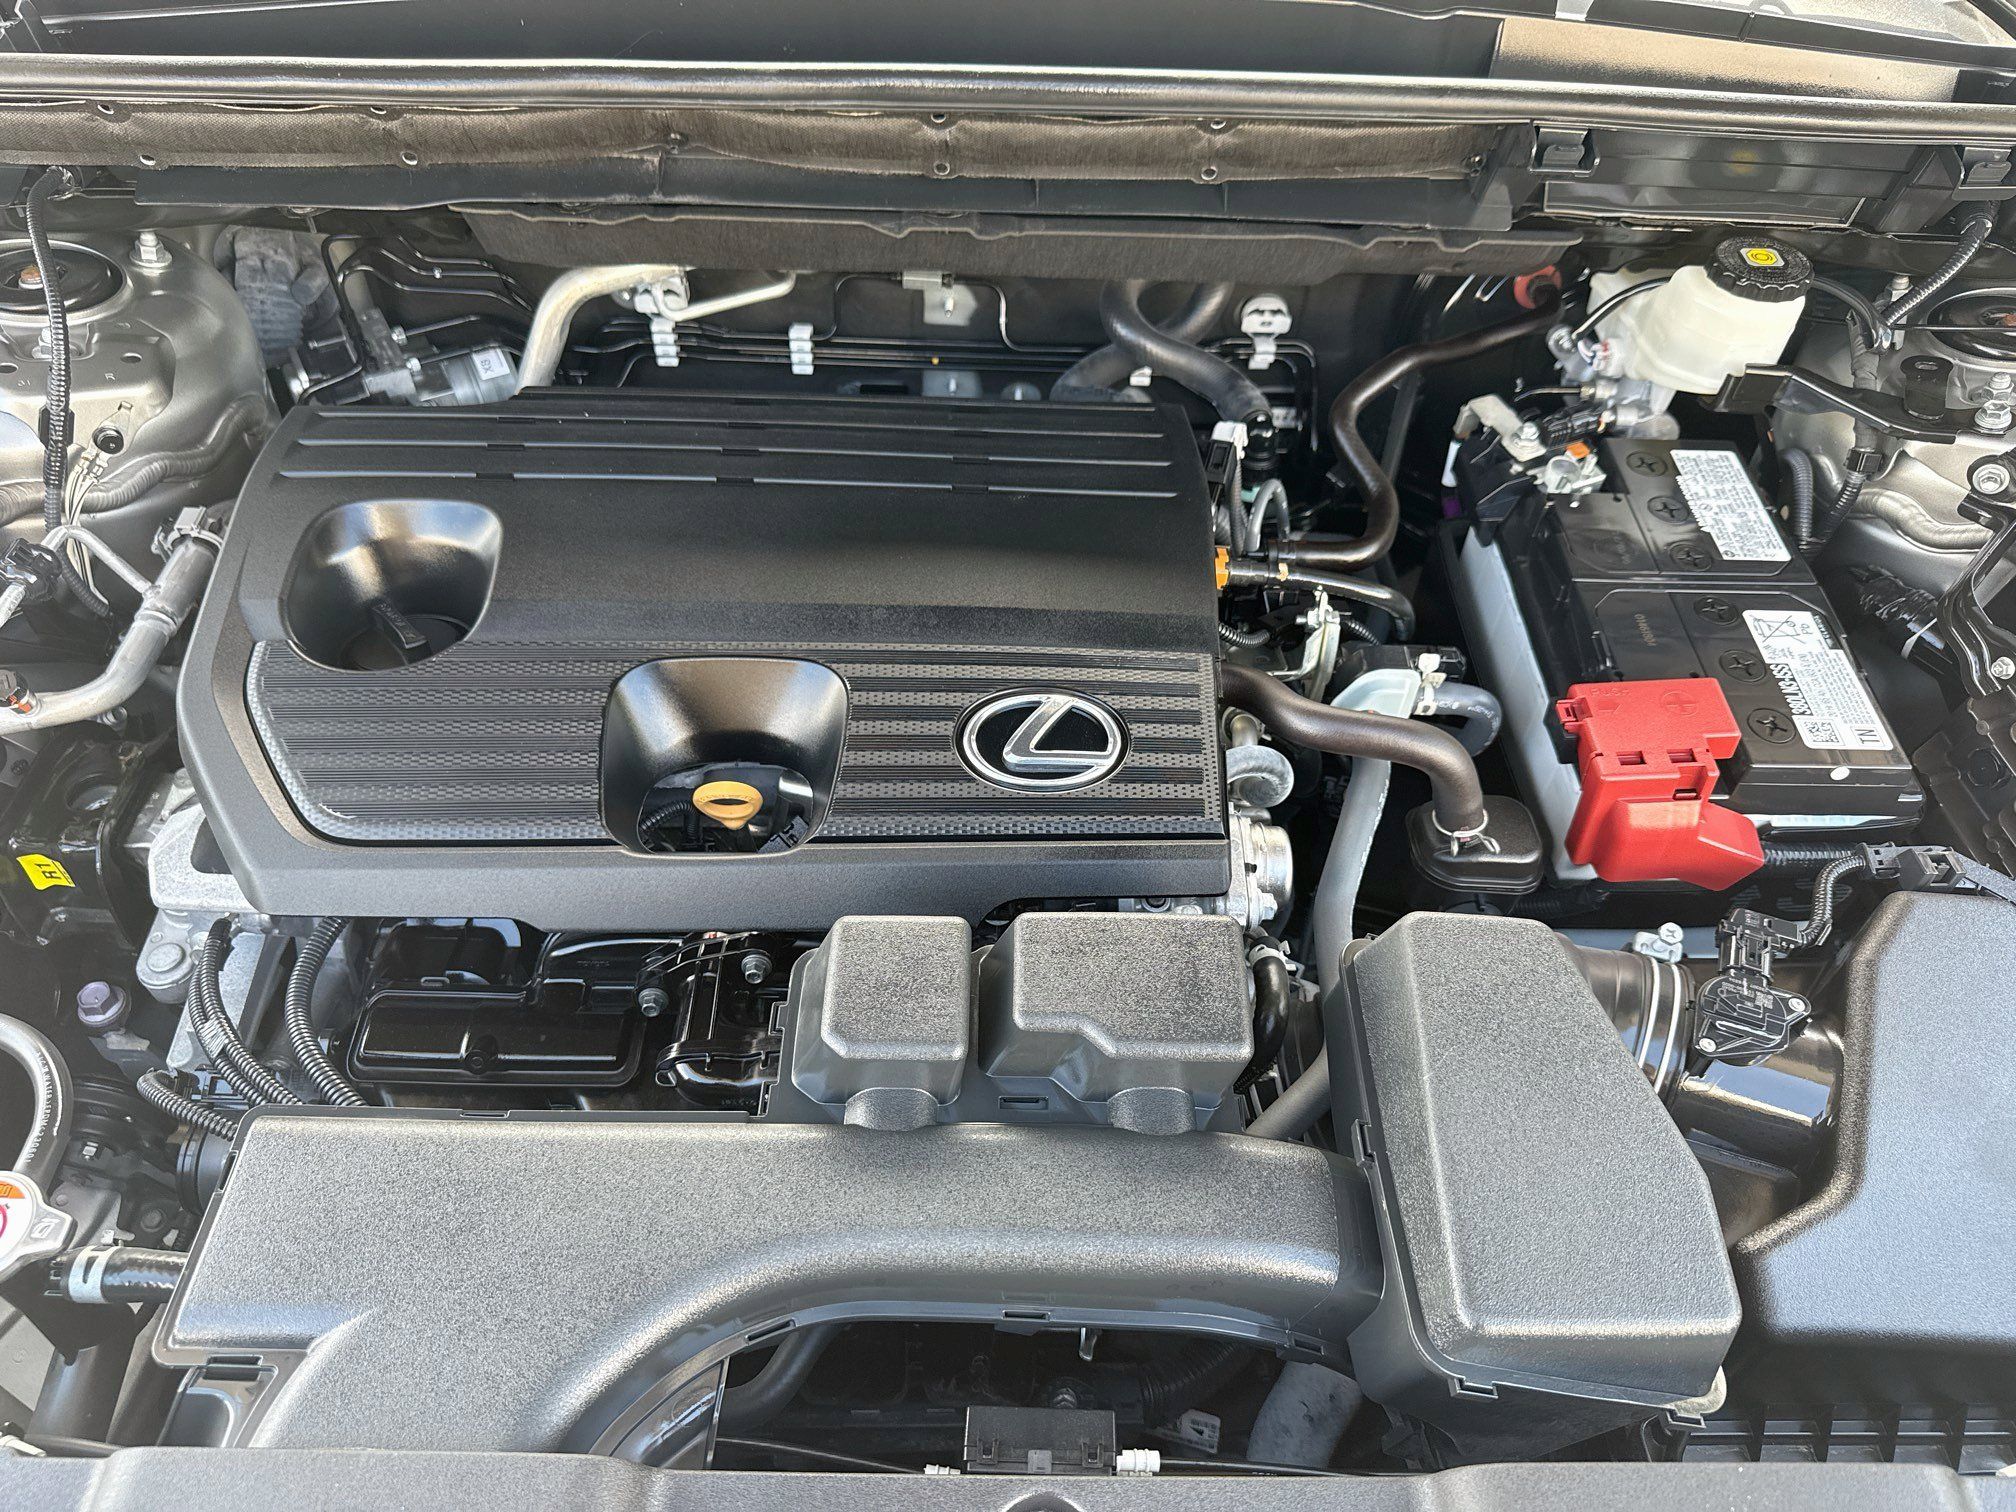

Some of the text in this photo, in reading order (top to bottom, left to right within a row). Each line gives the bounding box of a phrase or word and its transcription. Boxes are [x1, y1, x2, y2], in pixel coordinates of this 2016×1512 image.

[1769, 664, 1812, 715] 380LN3-ISS
[1854, 728, 1881, 745] TN
[35, 863, 62, 879] R1
